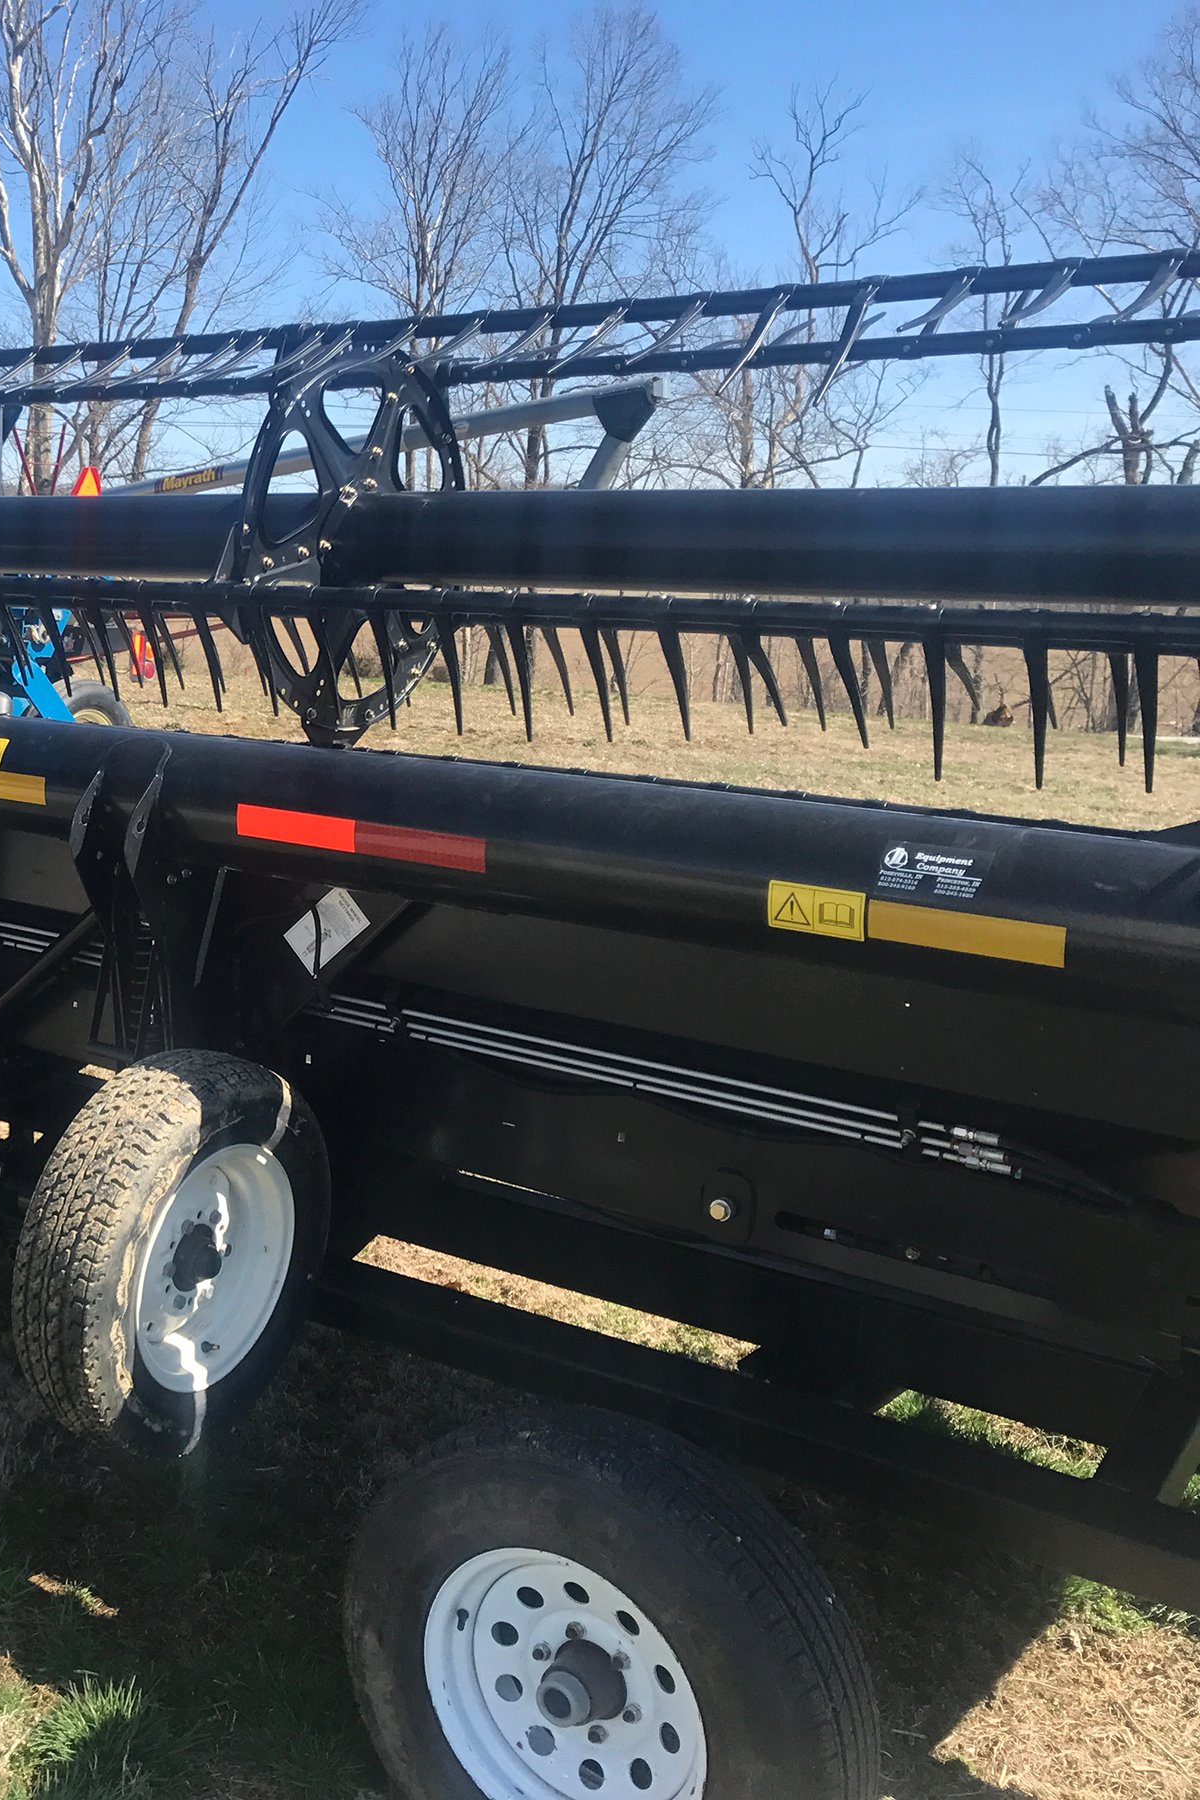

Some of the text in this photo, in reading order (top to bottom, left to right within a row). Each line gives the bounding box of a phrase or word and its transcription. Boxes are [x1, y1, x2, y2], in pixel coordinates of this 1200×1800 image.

[162, 468, 215, 491] Mayrath
[915, 852, 974, 866] Equipment
[916, 863, 966, 877] Company
